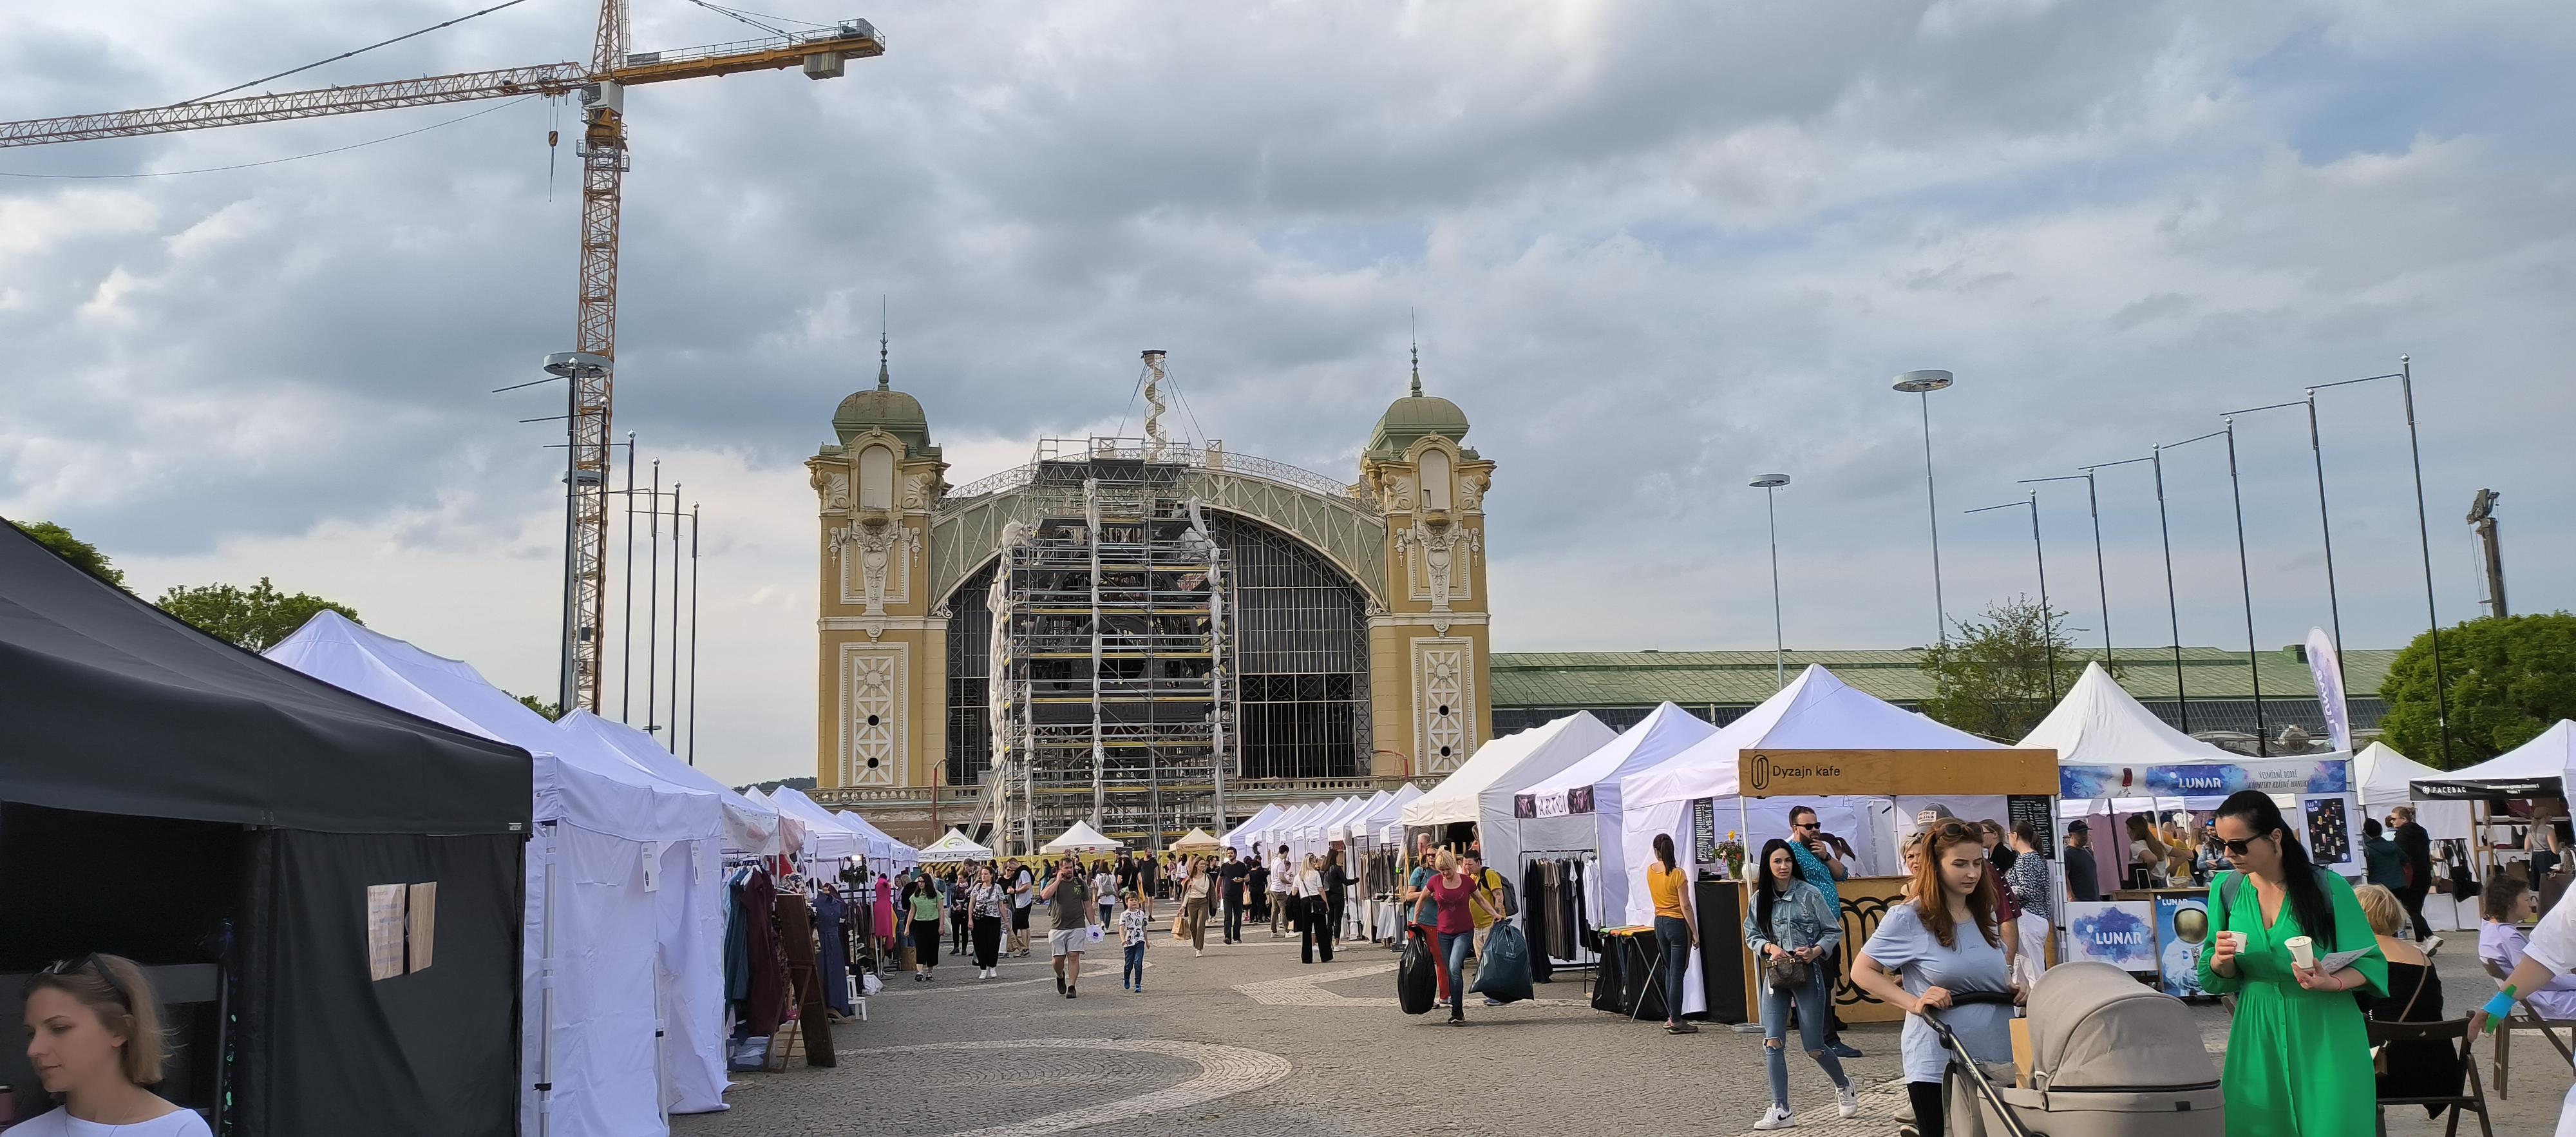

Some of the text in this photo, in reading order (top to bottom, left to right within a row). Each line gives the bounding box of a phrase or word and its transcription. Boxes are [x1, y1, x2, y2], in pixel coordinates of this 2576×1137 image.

[1773, 765, 1841, 779] Dyzajn kafe
[2179, 778, 2221, 788] LUNAR
[2096, 932, 2141, 944] LUNAR
